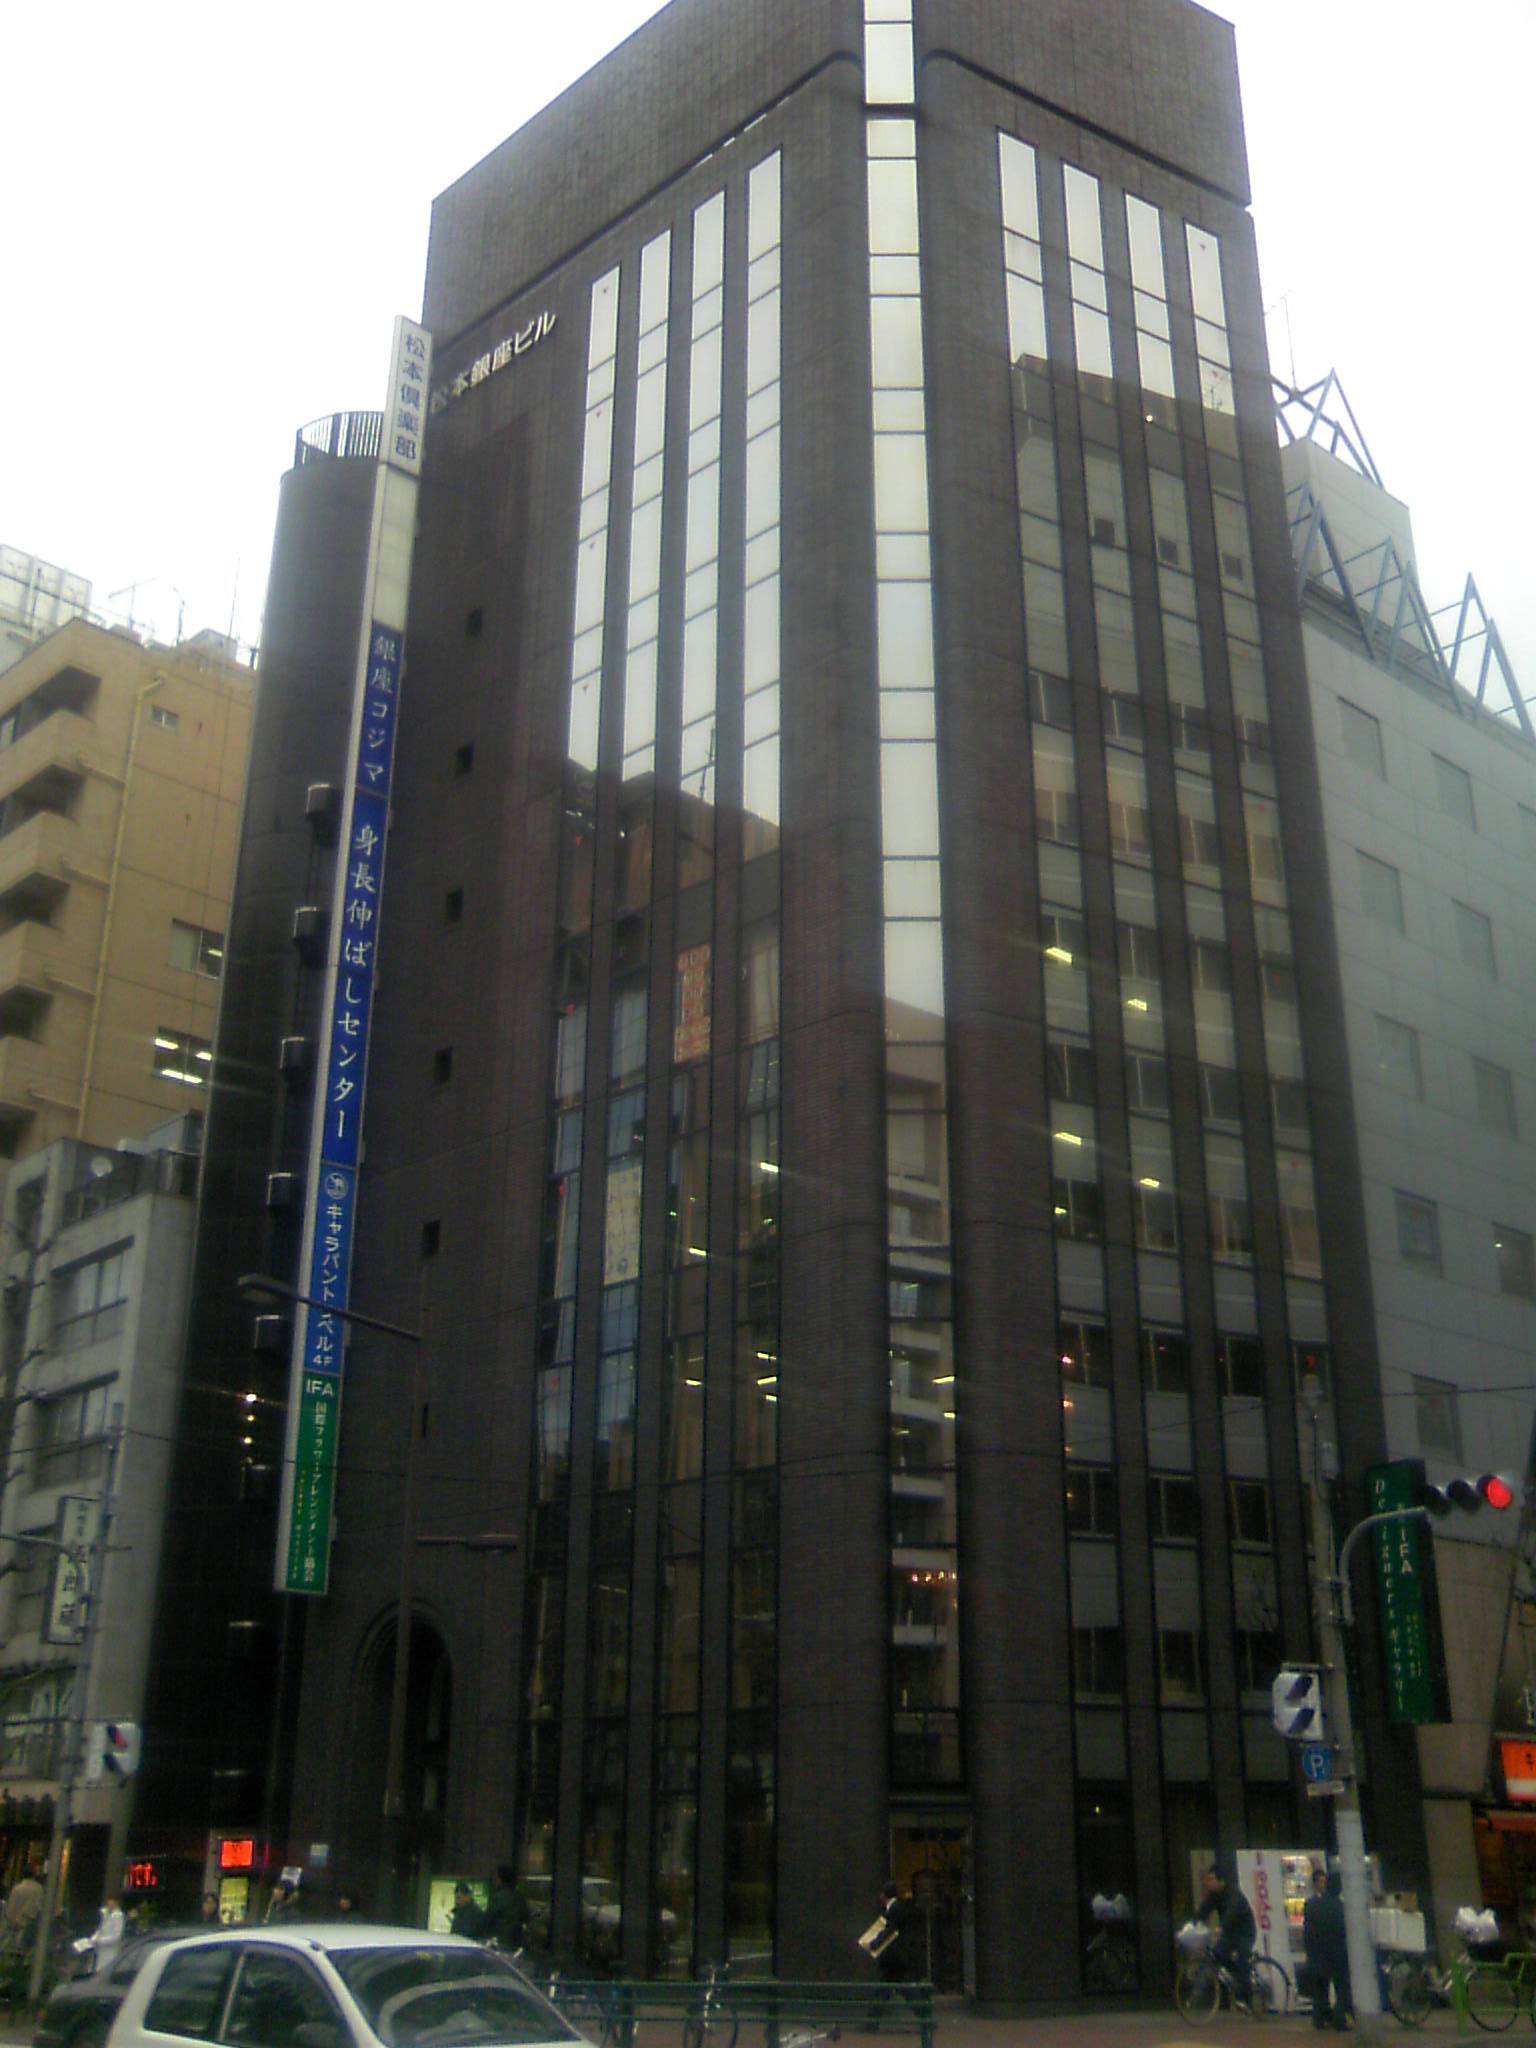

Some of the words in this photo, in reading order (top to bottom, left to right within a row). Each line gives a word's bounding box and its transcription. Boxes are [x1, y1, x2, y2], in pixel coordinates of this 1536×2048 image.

[363, 634, 397, 783] 銀座コジマ
[331, 823, 378, 1138] 身長伸ばしセンター
[315, 1203, 343, 1352] キャラバントベル
[305, 1378, 335, 1398] IFA
[312, 1353, 334, 1367] 4F
[1375, 1478, 1396, 1619] Deigners
[1310, 1754, 1324, 1777] P
